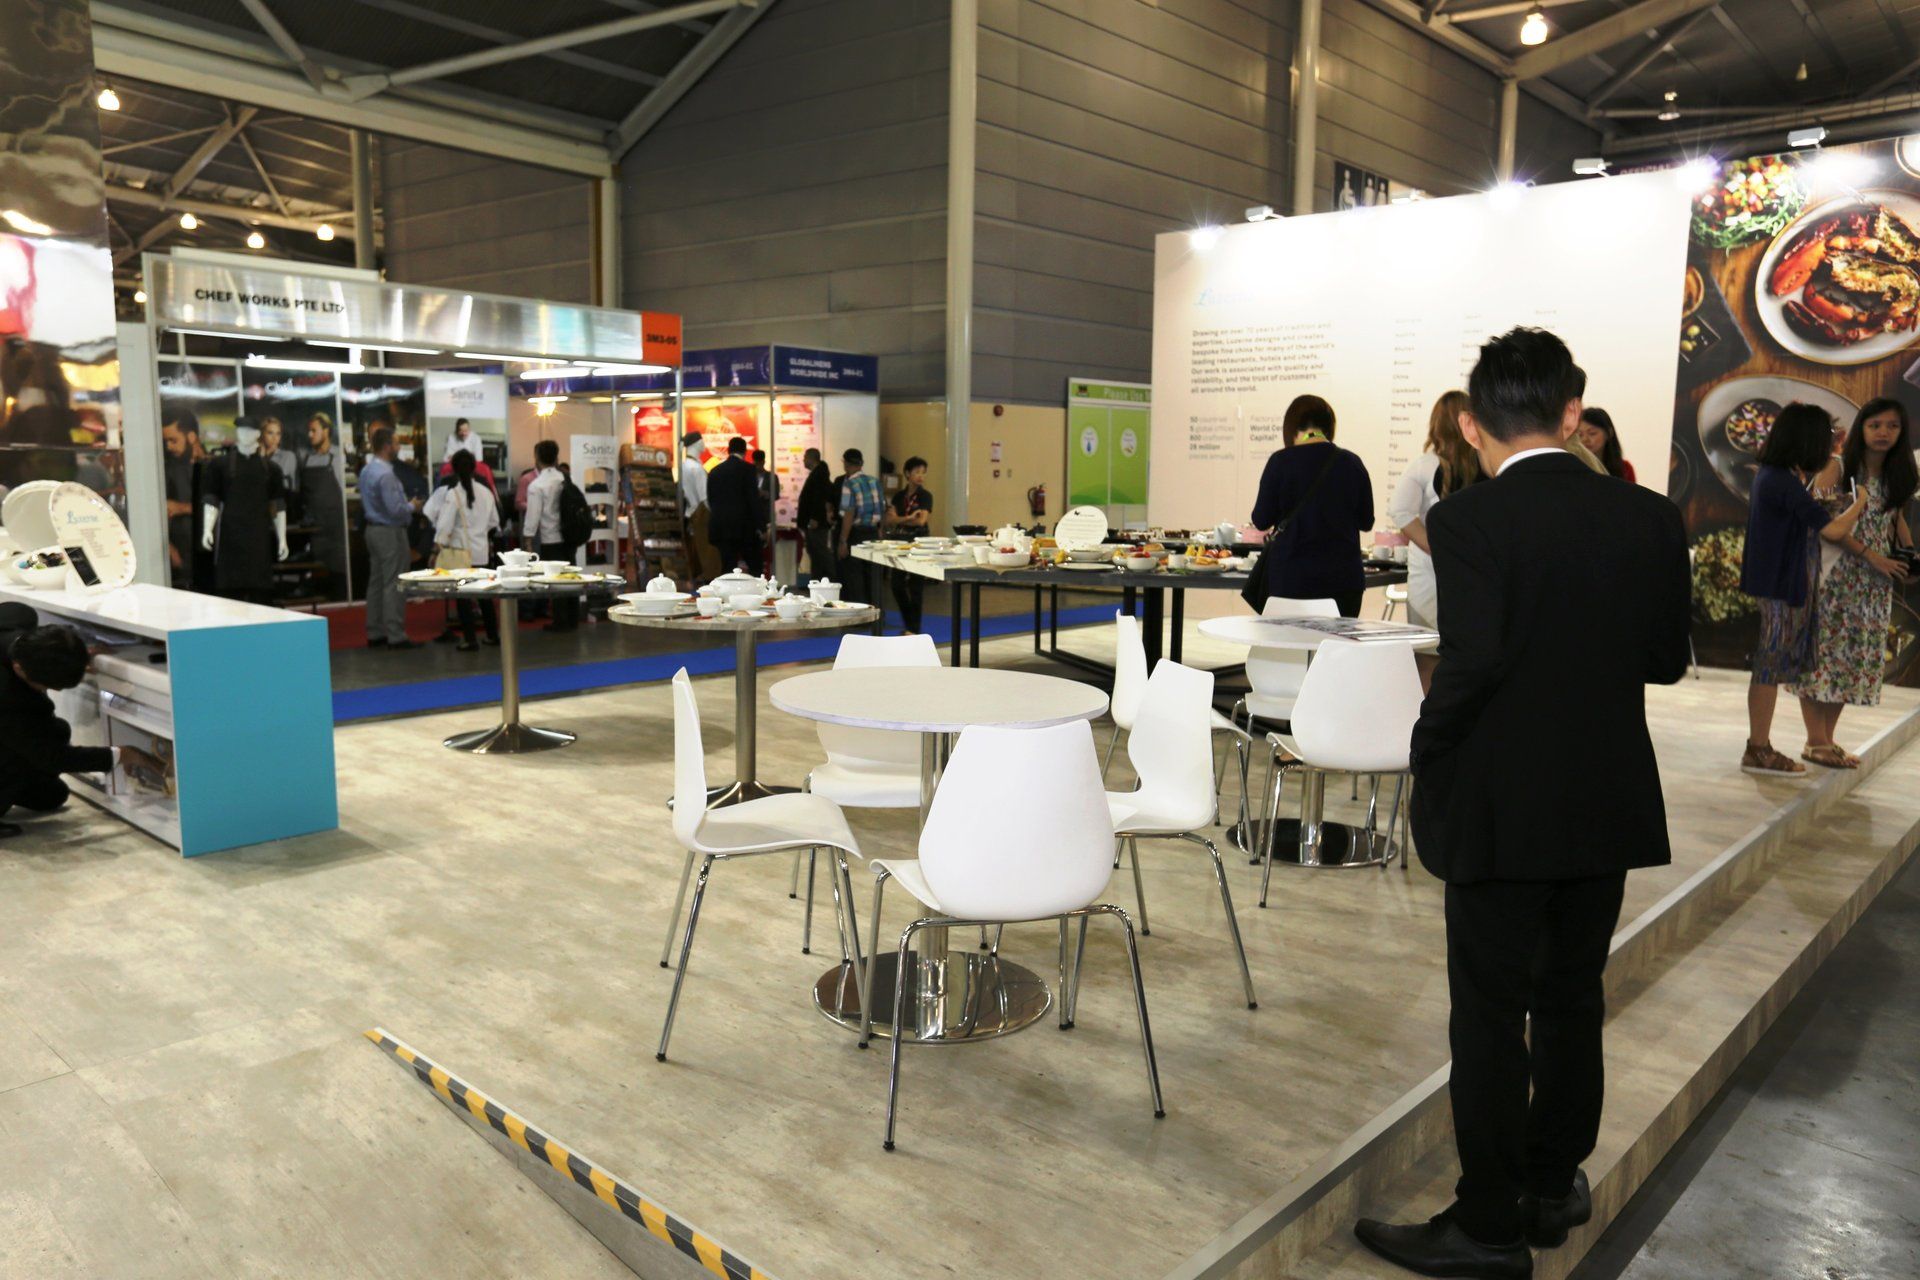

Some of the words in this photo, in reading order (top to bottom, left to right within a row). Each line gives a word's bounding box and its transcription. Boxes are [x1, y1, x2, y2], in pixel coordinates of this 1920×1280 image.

[195, 289, 233, 302] CHEF
[238, 293, 290, 309] WORKS
[295, 299, 318, 311] PTE
[322, 302, 344, 314] LTD
[1192, 329, 1218, 338] Drawing
[1192, 348, 1219, 356] bespoke
[1191, 357, 1216, 366] leading
[1259, 354, 1281, 362] hotels
[1283, 353, 1296, 361] and
[1191, 367, 1202, 375] Our
[1229, 365, 1266, 373] associated
[1284, 363, 1308, 371] quality
[1310, 362, 1323, 370] and
[1252, 374, 1269, 382] trust
[1270, 373, 1278, 381] of
[1279, 373, 1317, 381] customers
[1224, 385, 1235, 393] the
[1250, 424, 1270, 432] World
